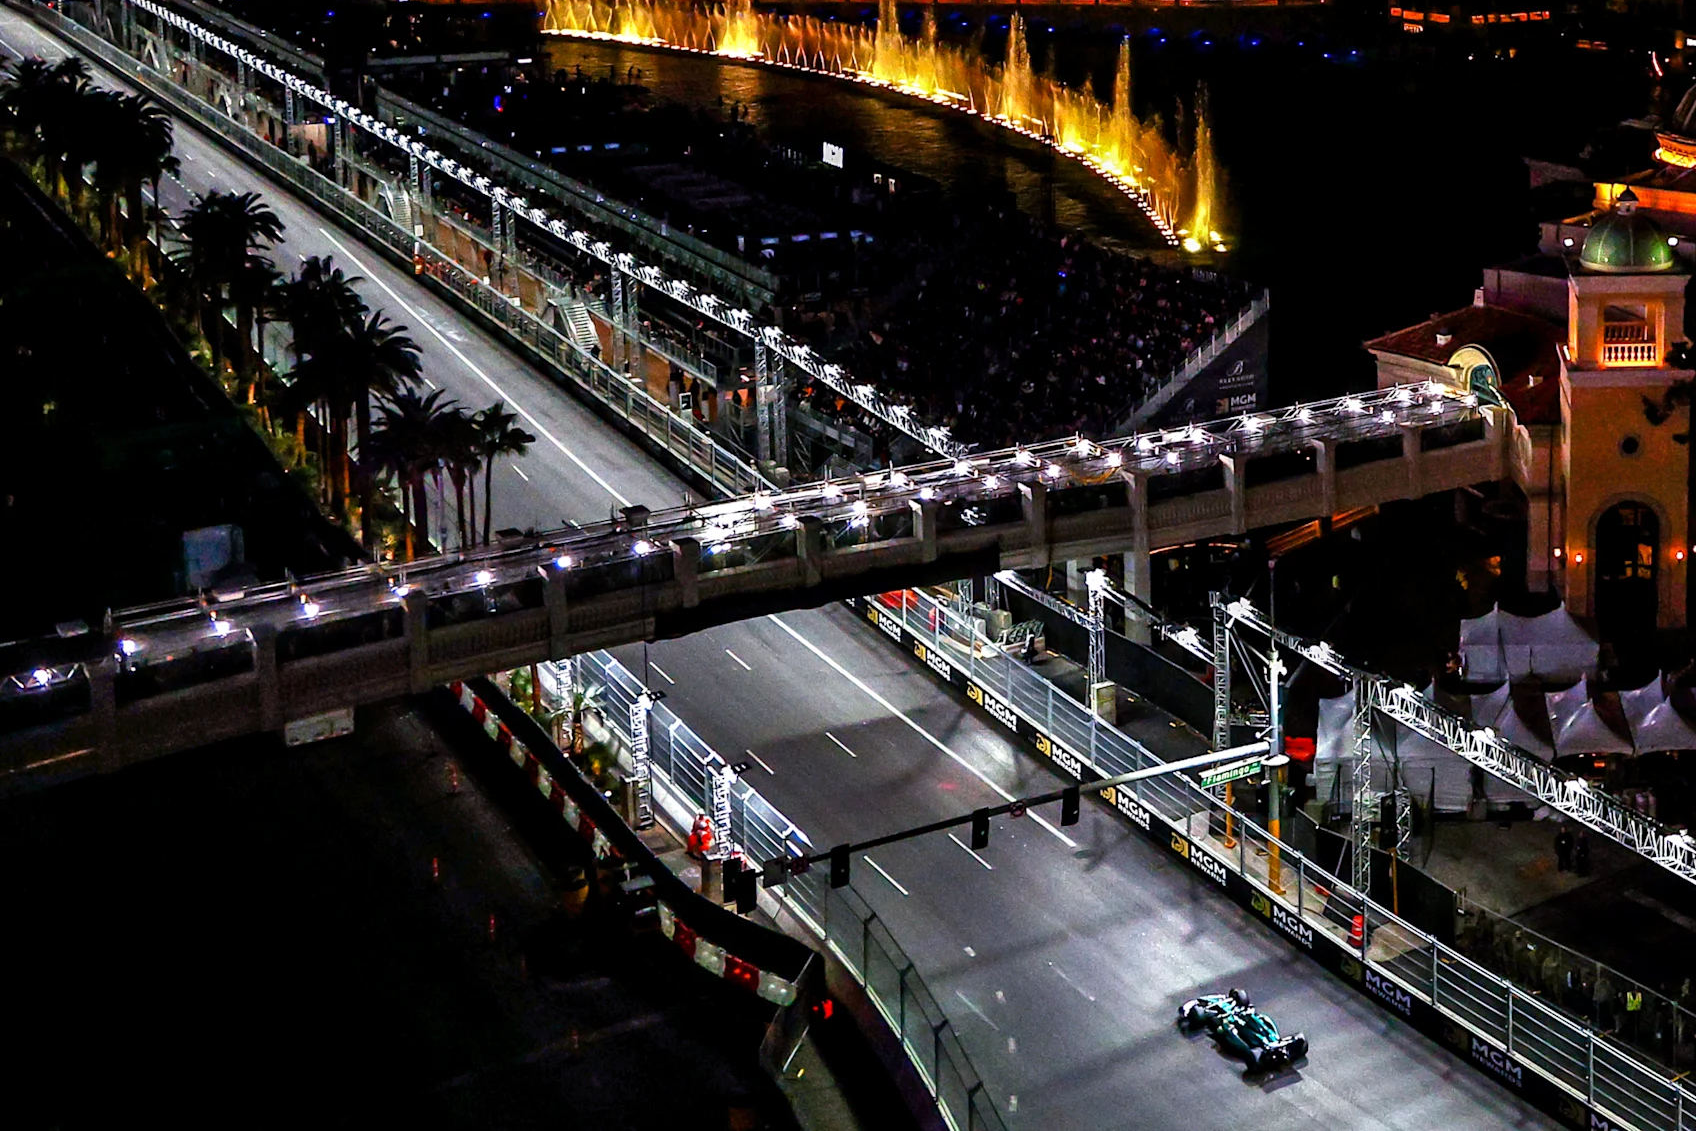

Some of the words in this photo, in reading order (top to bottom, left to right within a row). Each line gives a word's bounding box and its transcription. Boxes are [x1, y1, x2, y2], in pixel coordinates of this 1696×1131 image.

[1231, 393, 1257, 406] MGM
[879, 613, 901, 637] MGM
[927, 650, 951, 675] MGM
[984, 694, 1017, 726] MGM
[1052, 744, 1082, 774] MGM
[1206, 765, 1250, 784] Flamingo
[1118, 792, 1150, 824] MGM
[1118, 804, 1150, 830] REWARDS
[1191, 845, 1226, 879] MGM
[1191, 856, 1227, 886] REWARDS
[1273, 905, 1313, 942] MGM
[1273, 917, 1313, 949] REWARDS
[1366, 970, 1411, 1008] MGM
[1366, 982, 1411, 1016] REWARDS
[1472, 1037, 1522, 1080] MGM
[1472, 1051, 1522, 1088] REWARDS
